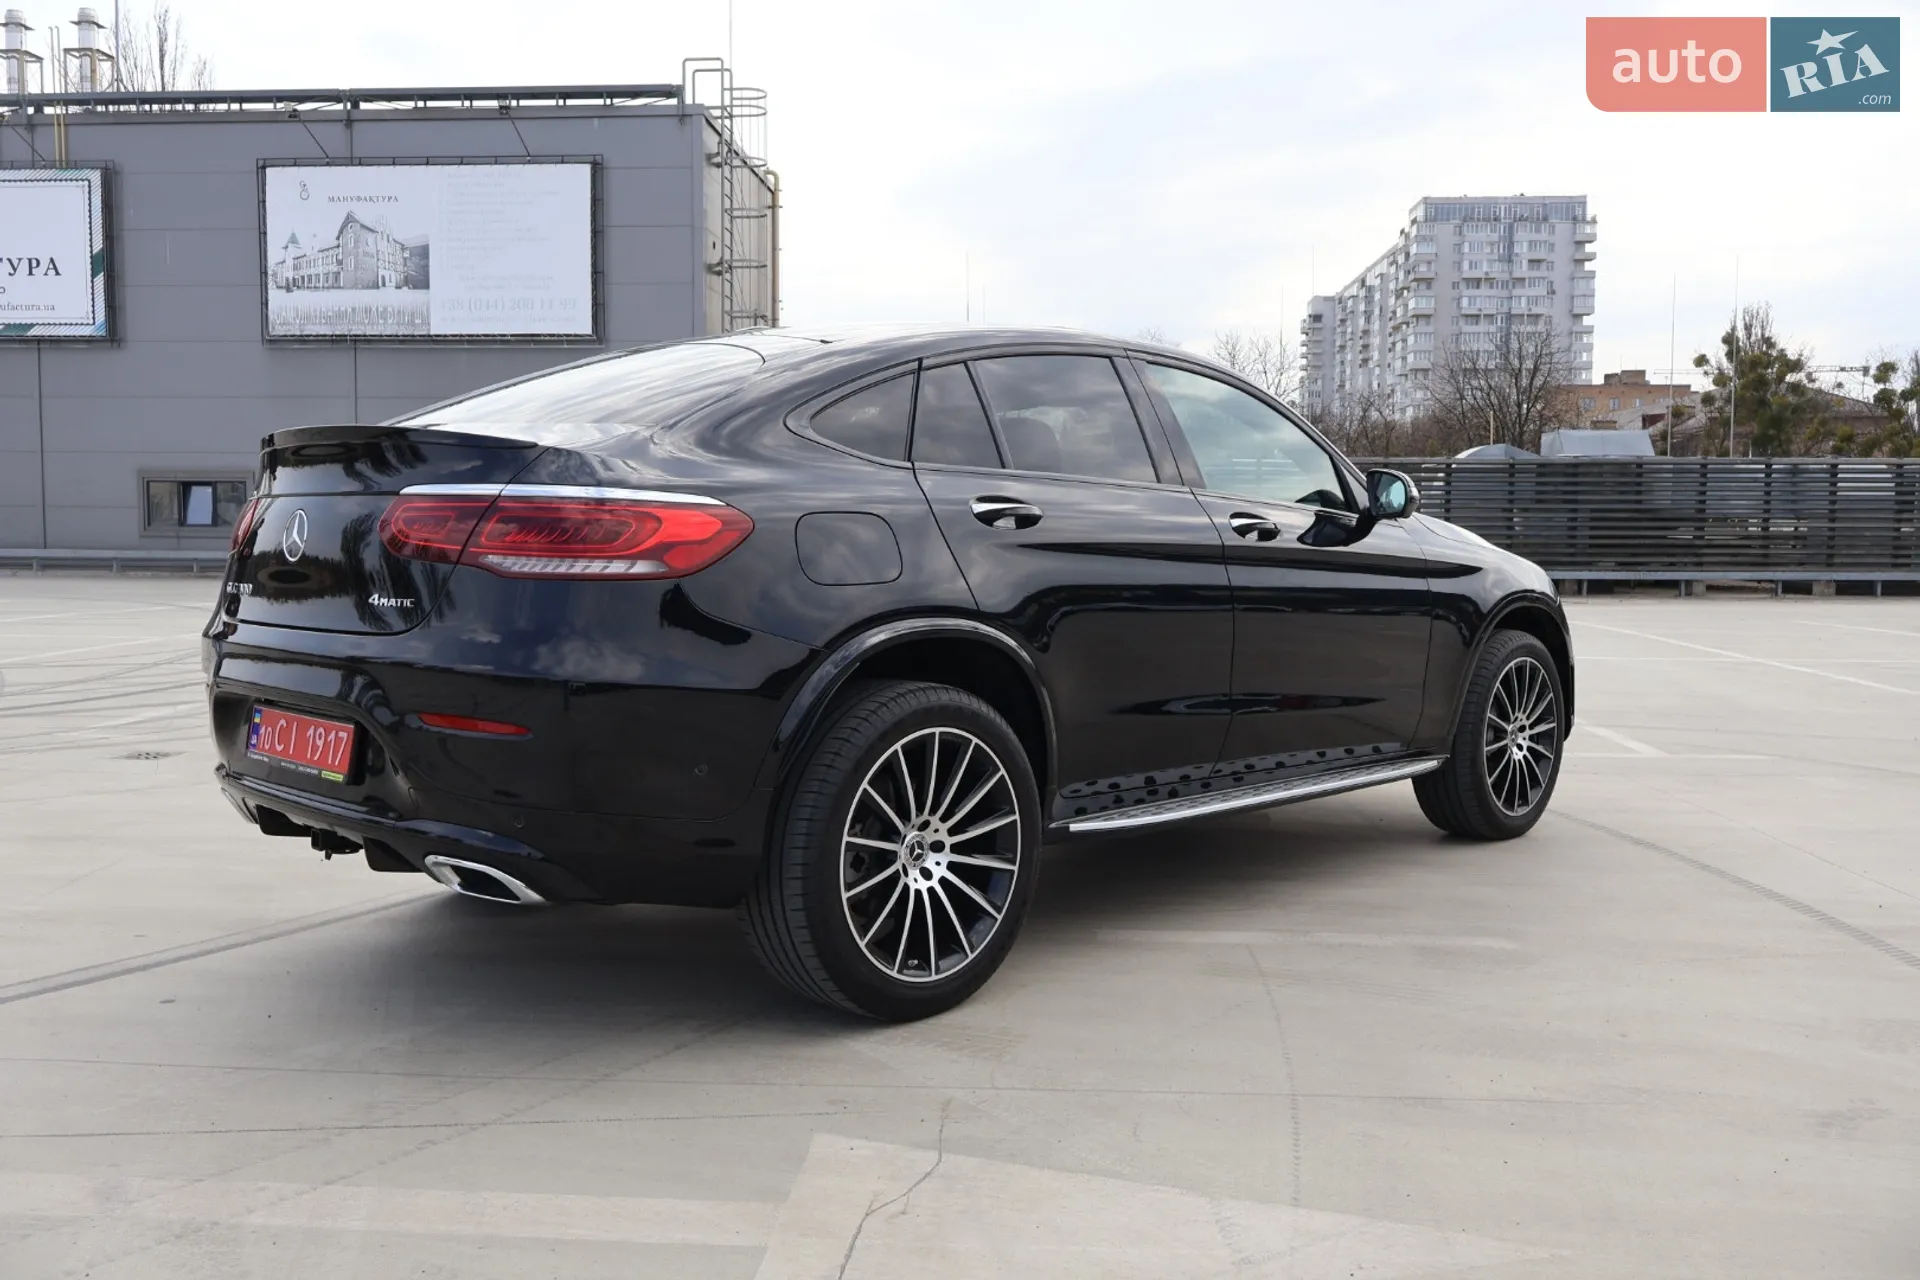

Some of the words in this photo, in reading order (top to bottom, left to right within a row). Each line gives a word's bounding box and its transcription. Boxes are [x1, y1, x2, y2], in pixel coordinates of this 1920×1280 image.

[327, 195, 399, 204] МАНУФАКТУРА
[0, 256, 62, 277] УРА
[0, 301, 56, 312] ufactura.ua
[368, 593, 415, 607] 4MATIC
[259, 724, 272, 750] 10
[306, 724, 348, 766] 1917
